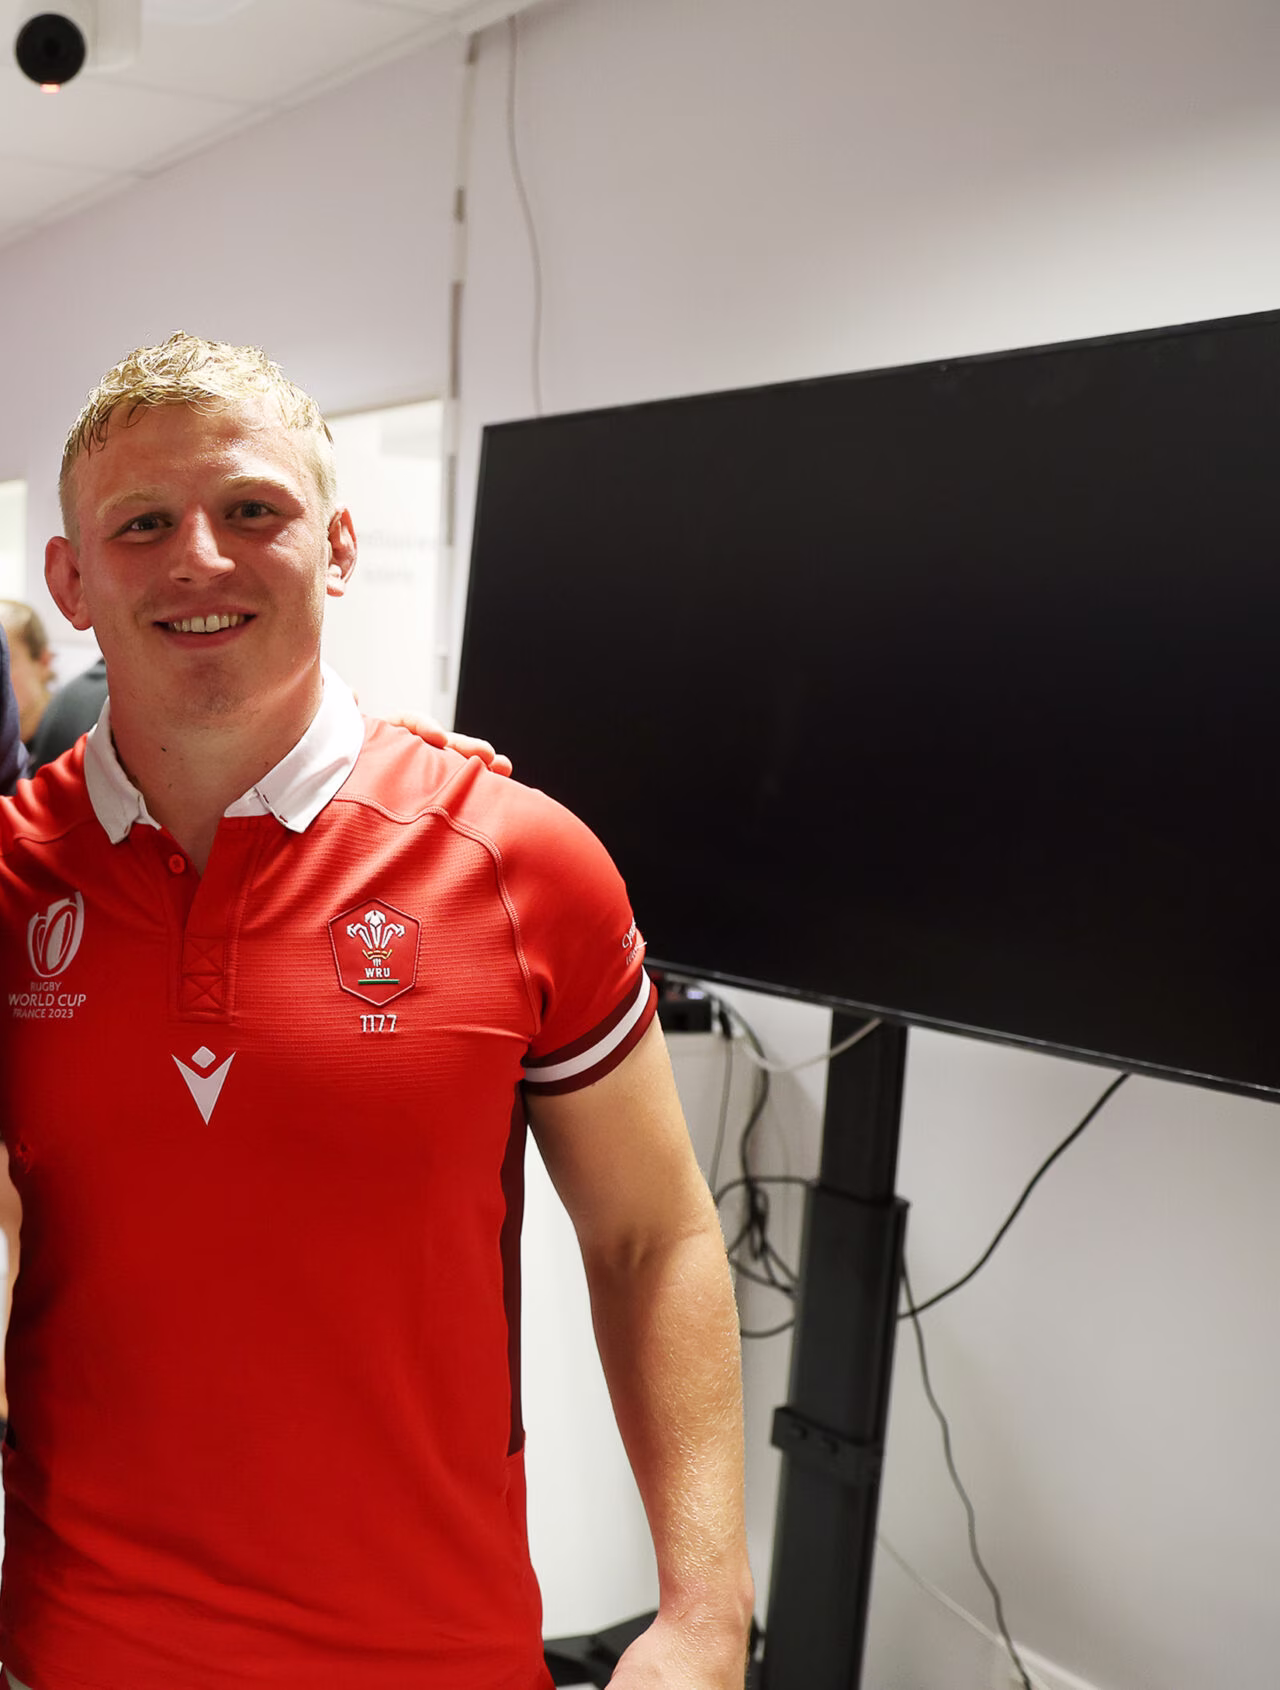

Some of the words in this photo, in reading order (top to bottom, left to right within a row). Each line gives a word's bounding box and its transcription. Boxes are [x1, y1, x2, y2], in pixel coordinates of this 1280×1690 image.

[364, 967, 391, 978] WRU
[30, 981, 62, 992] RUGBY
[8, 993, 55, 1007] WORLD
[57, 993, 87, 1007] CUP
[13, 1008, 46, 1018] FRANCE
[48, 1008, 74, 1018] 2023
[359, 1014, 397, 1032] 1177
